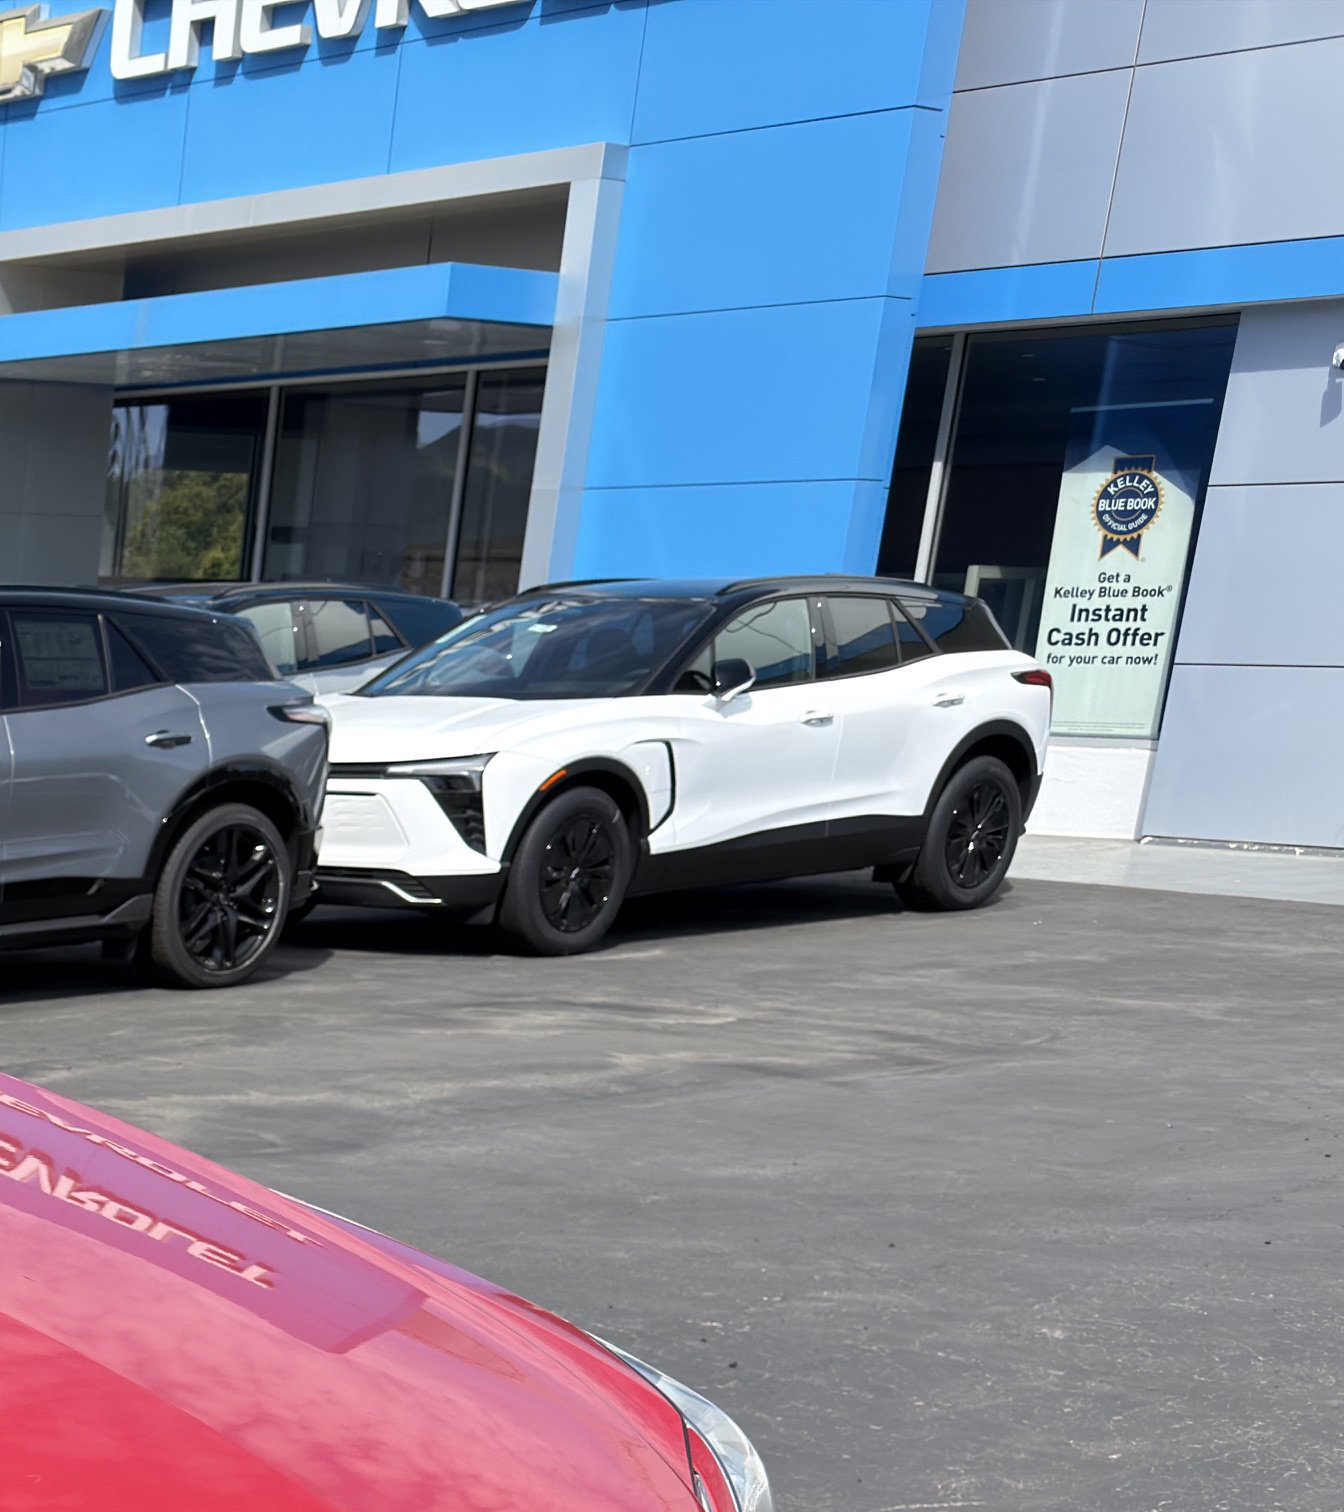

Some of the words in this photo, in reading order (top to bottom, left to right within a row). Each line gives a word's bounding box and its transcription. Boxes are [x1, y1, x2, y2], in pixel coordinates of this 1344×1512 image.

[1107, 475, 1155, 495] KELLEY
[1098, 498, 1125, 511] BLUE
[1127, 497, 1157, 510] BOOK
[1102, 513, 1128, 531] OFFICIAL
[1128, 513, 1148, 530] GUIDE
[1098, 572, 1120, 583] Get
[1123, 574, 1131, 583] a
[1054, 587, 1095, 600] Kelley
[1098, 586, 1128, 598] Blue
[1070, 604, 1148, 622] Instant
[1047, 628, 1099, 646] Cash
[1107, 628, 1165, 647] Offer
[1046, 653, 1065, 664] for
[1068, 656, 1098, 667] your
[1101, 656, 1122, 665] car
[1125, 654, 1158, 665] now!
